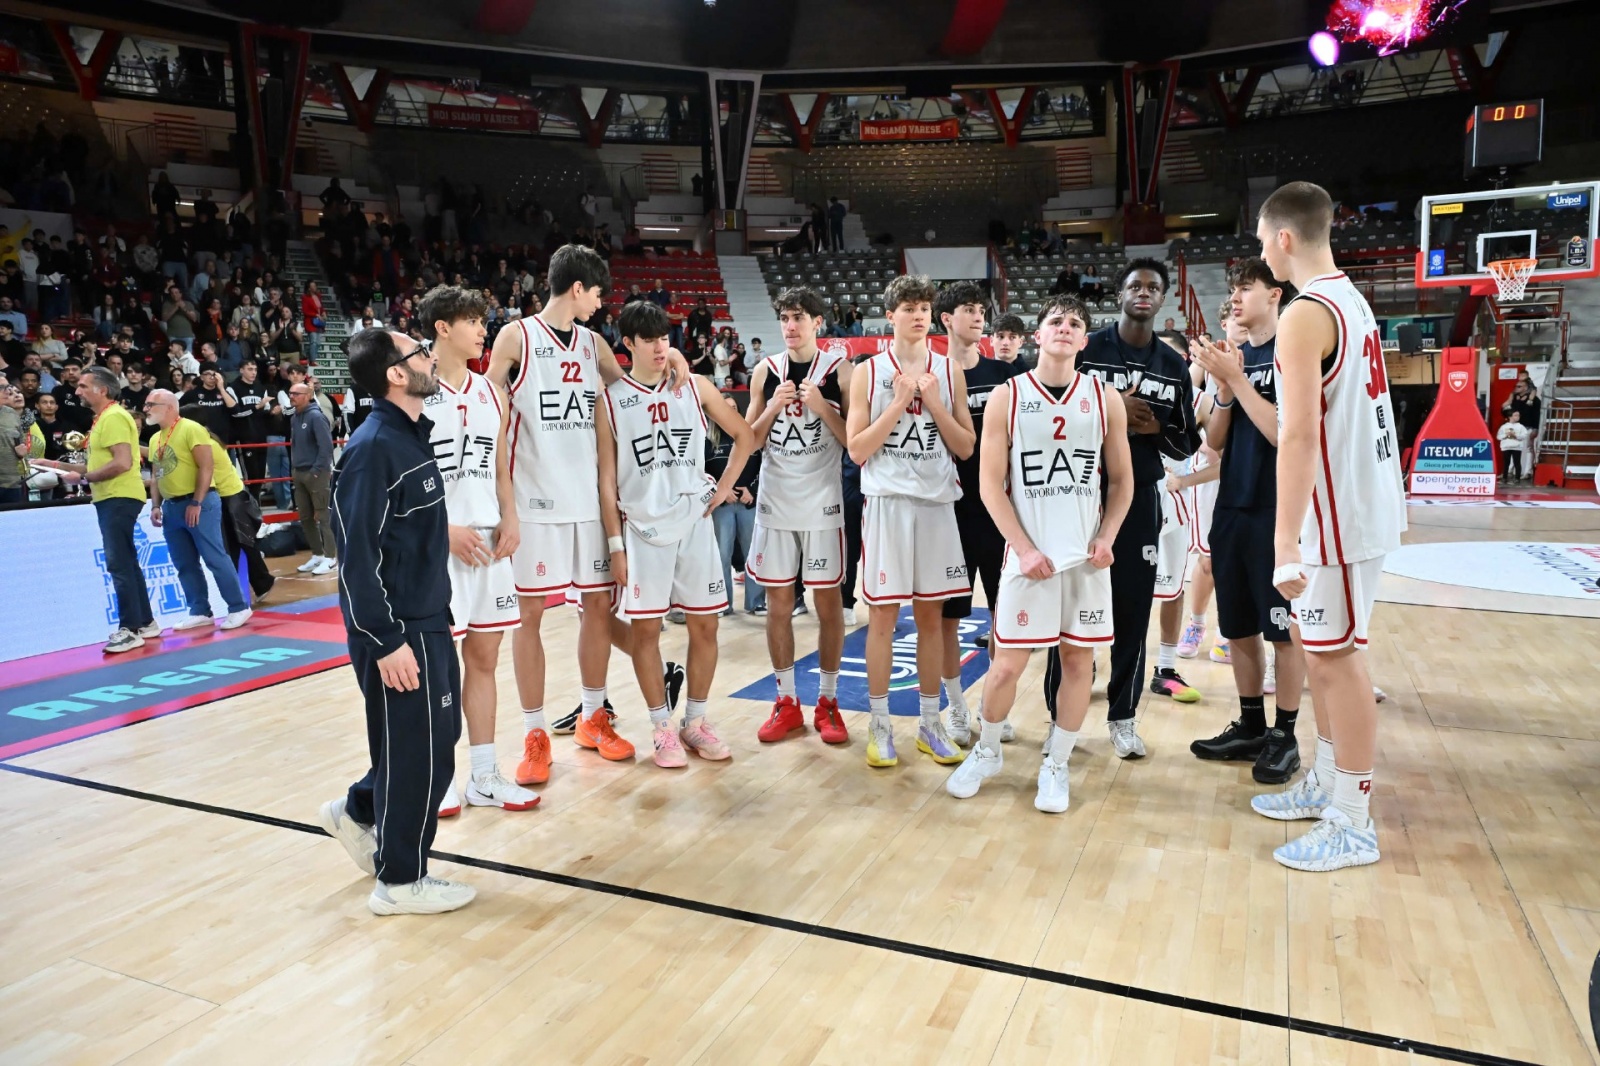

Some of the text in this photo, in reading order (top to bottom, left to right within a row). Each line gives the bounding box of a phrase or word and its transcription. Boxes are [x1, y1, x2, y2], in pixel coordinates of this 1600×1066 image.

[433, 110, 519, 125] NOI SIAMO VARESE
[864, 125, 941, 135] NOI SIAMO VARESE
[1555, 195, 1581, 206] Unipol
[560, 361, 583, 383] 22
[539, 390, 596, 421] EA7
[619, 394, 639, 407] EA7
[457, 404, 468, 427] 7
[647, 401, 669, 425] 20
[769, 417, 821, 448] EA7
[1053, 416, 1067, 440] 2
[429, 434, 494, 473] EA7
[632, 429, 694, 467] EA7
[1424, 446, 1473, 457] ITELYUM
[1020, 448, 1096, 486] EA7
[1416, 475, 1491, 485] Openjobmetis
[1080, 609, 1104, 621] EA7
[1301, 609, 1325, 622] EA7
[7, 646, 313, 721] ARENA
